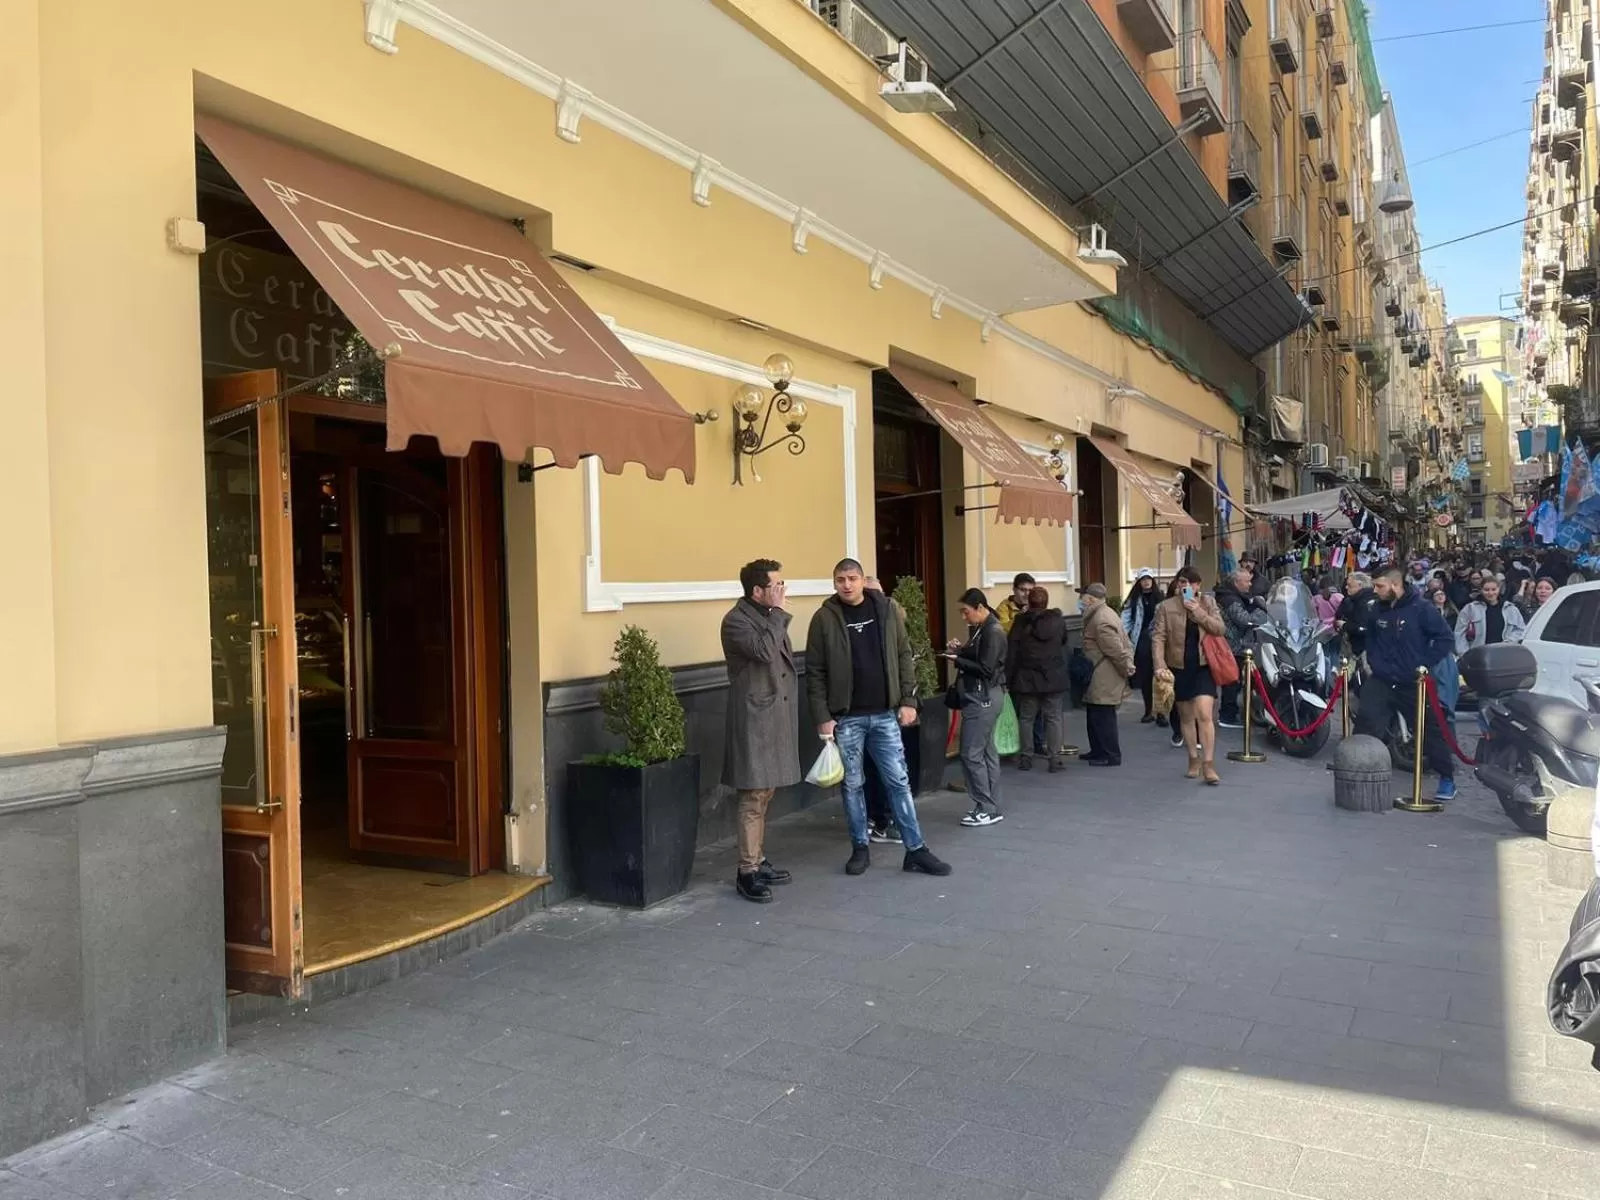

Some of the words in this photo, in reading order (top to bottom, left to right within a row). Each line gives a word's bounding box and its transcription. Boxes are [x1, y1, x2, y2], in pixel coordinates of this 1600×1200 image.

[216, 247, 337, 317] Cera
[317, 220, 550, 314] Ceraldi
[229, 307, 345, 376] Caff
